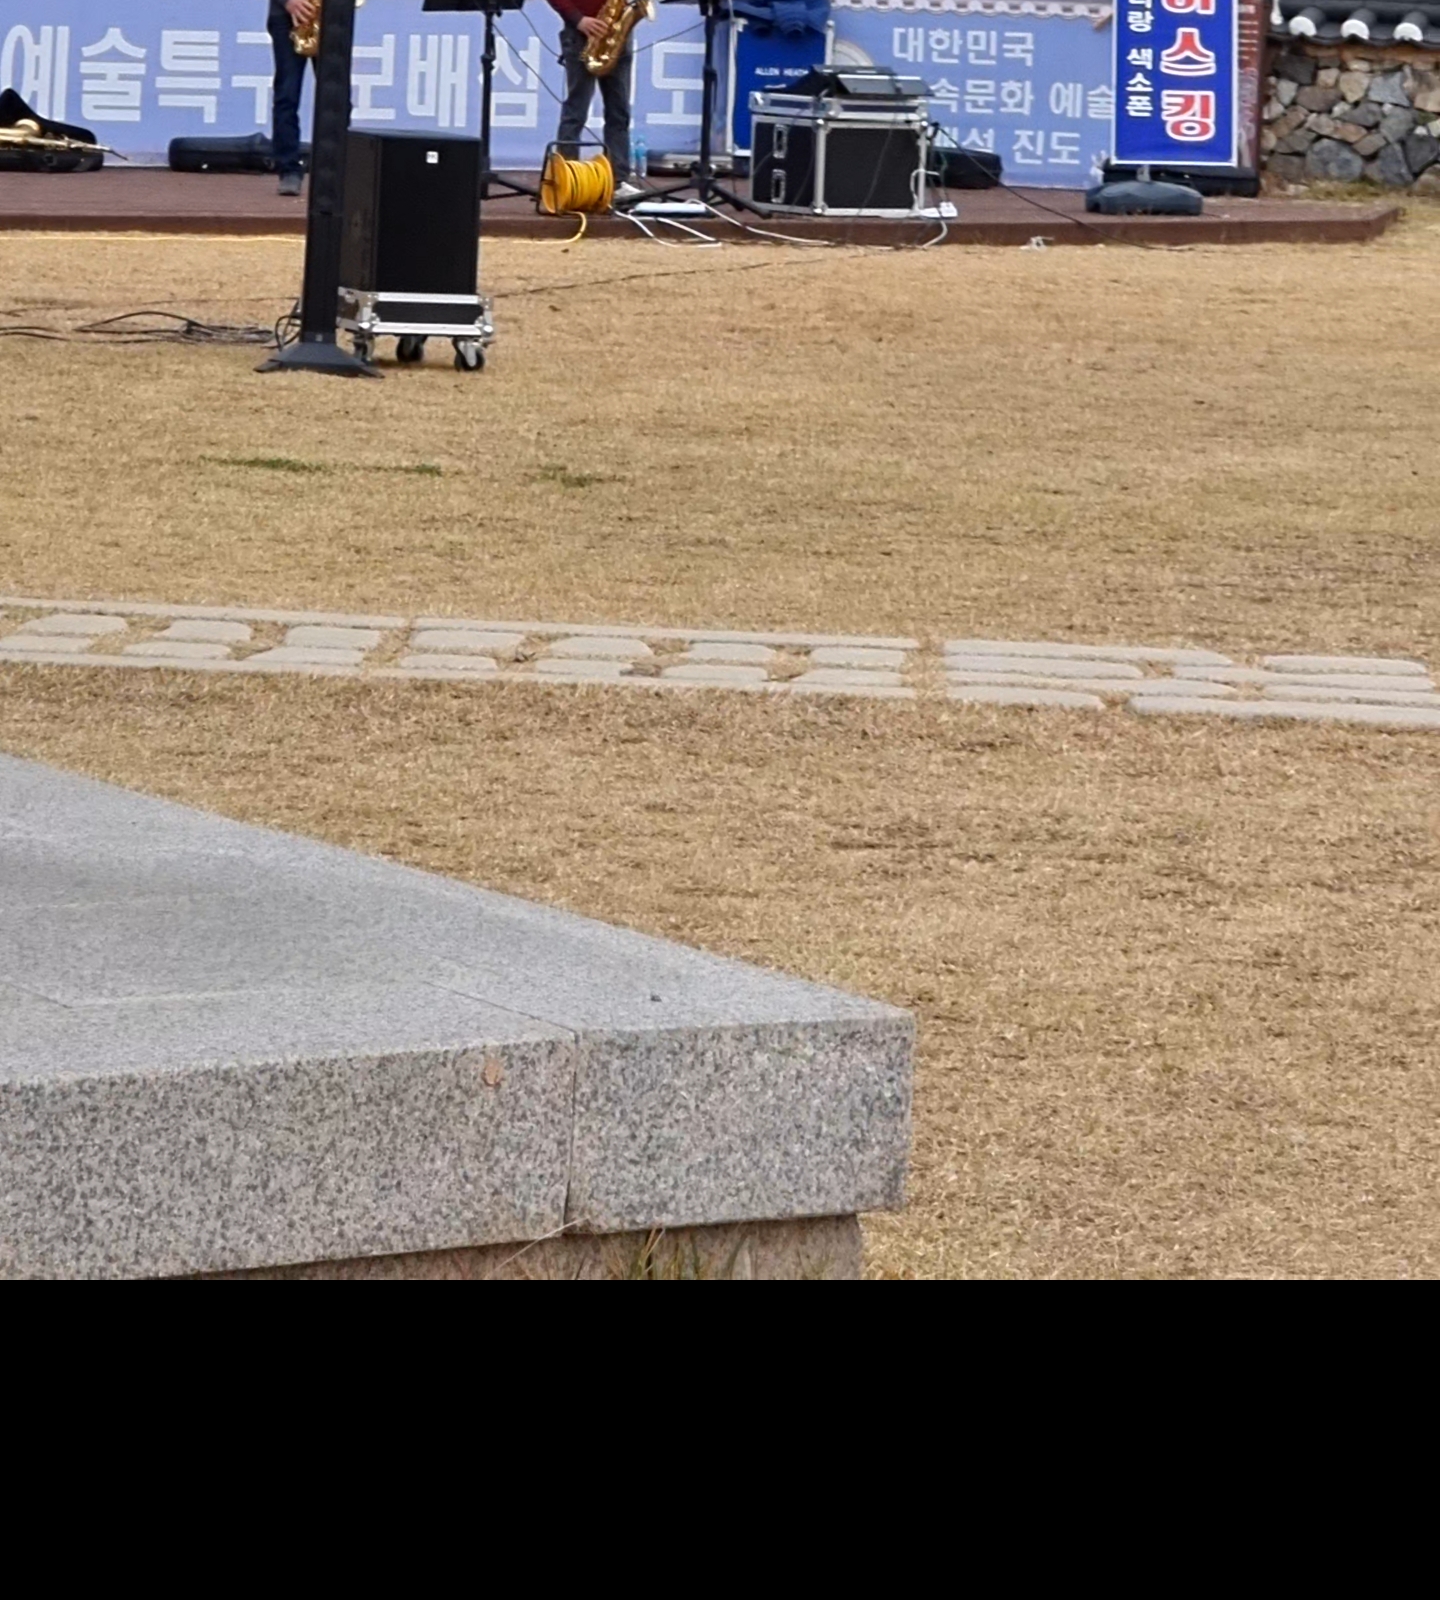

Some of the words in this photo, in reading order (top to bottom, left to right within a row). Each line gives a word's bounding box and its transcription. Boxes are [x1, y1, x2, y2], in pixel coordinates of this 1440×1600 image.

[893, 27, 1034, 67] 대한민국
[2, 23, 273, 125] 예술특구
[352, 33, 541, 128] 보배섬
[1125, 48, 1154, 118] 색소폰
[1050, 81, 1115, 120] 예술
[1013, 129, 1082, 166] 진도
